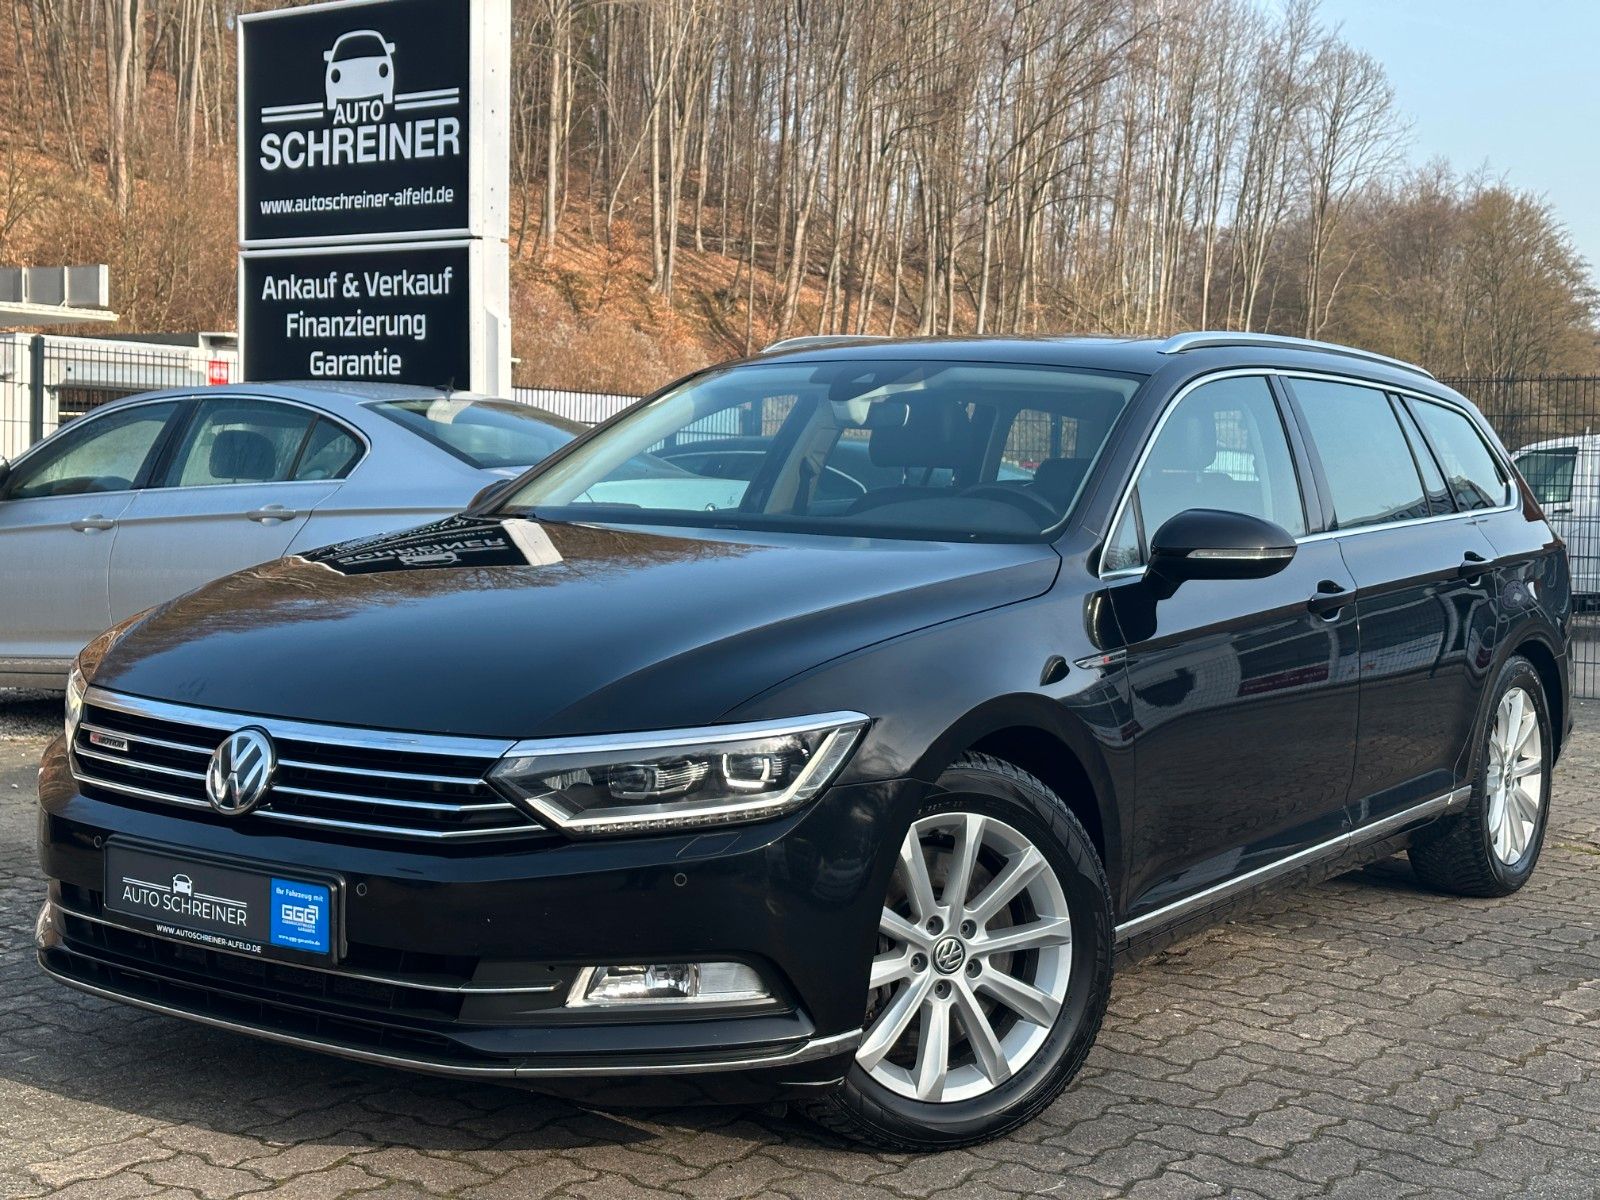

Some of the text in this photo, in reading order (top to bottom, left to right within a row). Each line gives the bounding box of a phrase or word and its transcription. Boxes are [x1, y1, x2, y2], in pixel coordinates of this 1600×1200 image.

[333, 99, 384, 125] AUTO
[259, 116, 461, 171] SCHREINER
[260, 186, 454, 215] www.autoschreiner-alfeld.de
[261, 266, 453, 300] Ankauf & Verkauf
[286, 308, 426, 341] Finanzierung
[309, 347, 402, 376] Garantie
[122, 885, 248, 927] AUTO SCHREINER
[285, 888, 313, 901] Fahrzeug
[281, 904, 316, 925] GGG
[156, 924, 262, 953] WWW.AUTOSCHREINER-ALFELD.DE
